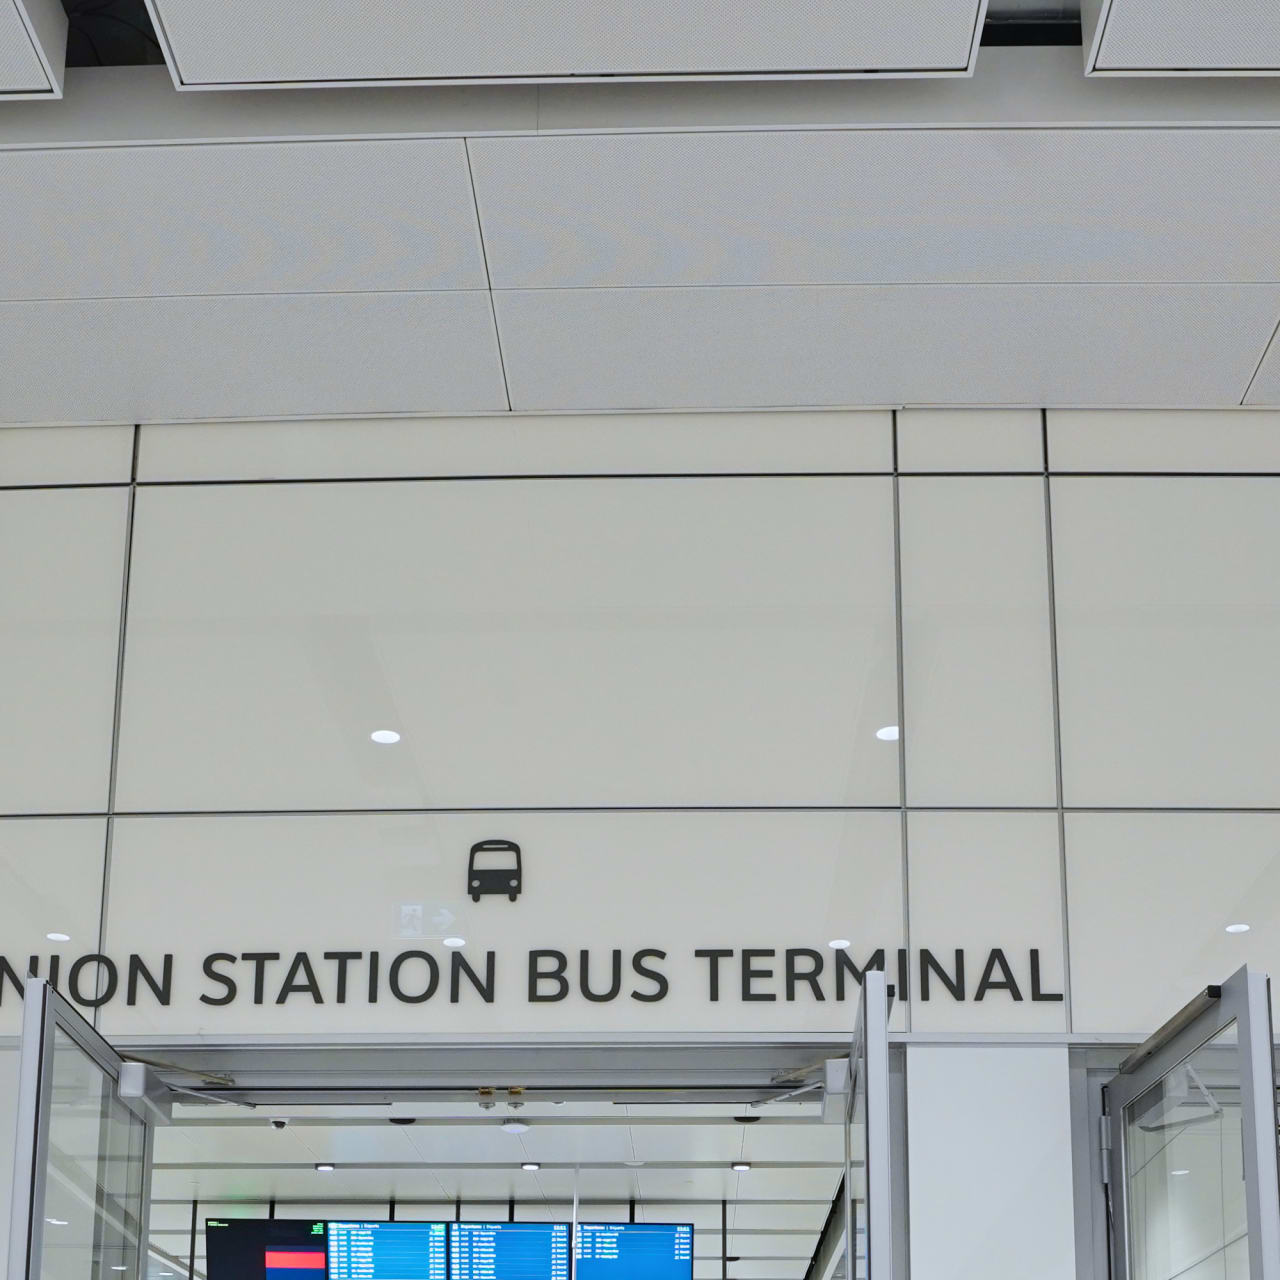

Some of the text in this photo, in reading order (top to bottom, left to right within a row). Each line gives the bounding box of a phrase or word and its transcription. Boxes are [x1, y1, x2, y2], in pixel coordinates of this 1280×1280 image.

[199, 950, 496, 1006] STATION
[528, 948, 669, 1003] BUS
[694, 948, 1064, 1001] TERMINAL
